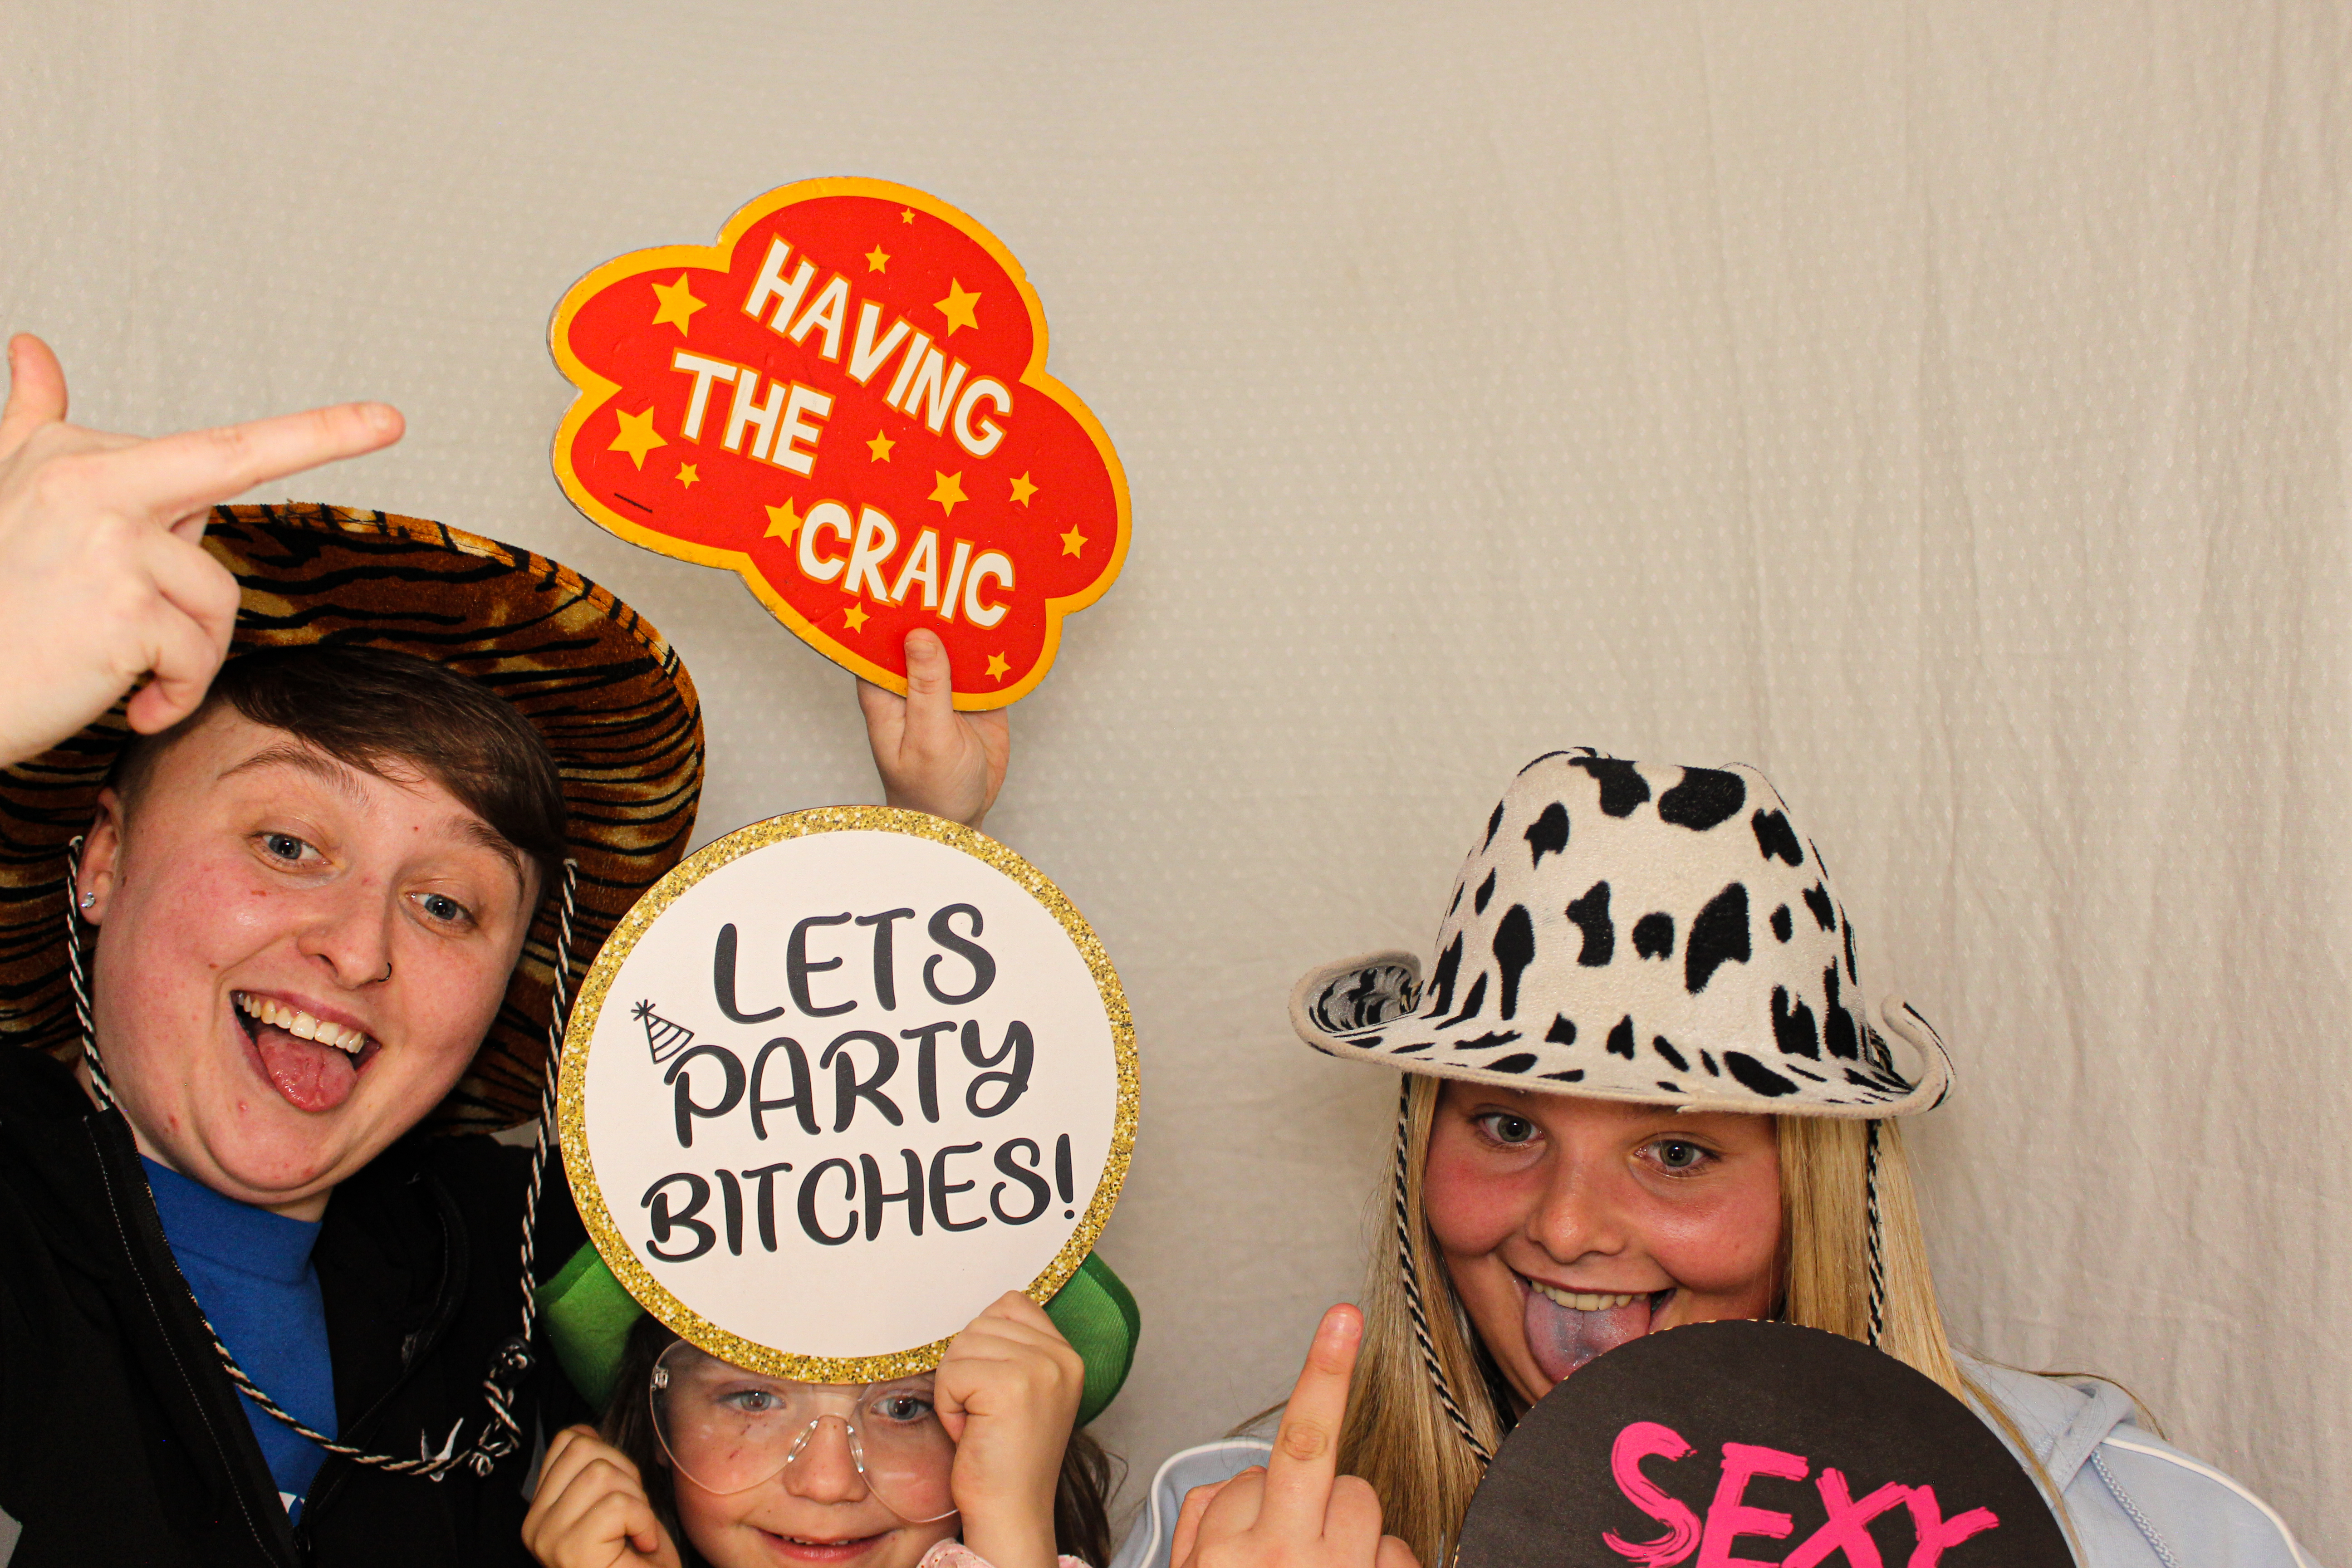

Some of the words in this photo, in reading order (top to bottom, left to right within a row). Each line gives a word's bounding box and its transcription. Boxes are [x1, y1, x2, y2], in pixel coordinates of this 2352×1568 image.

[744, 237, 1012, 457] HAVING
[673, 352, 833, 475] THE
[799, 502, 1014, 627] CRAIC
[713, 902, 996, 1024] LETS
[663, 1019, 1034, 1149] PARTY
[640, 1133, 1076, 1263] BITCHES!
[1602, 1421, 1999, 1568] SEXY
